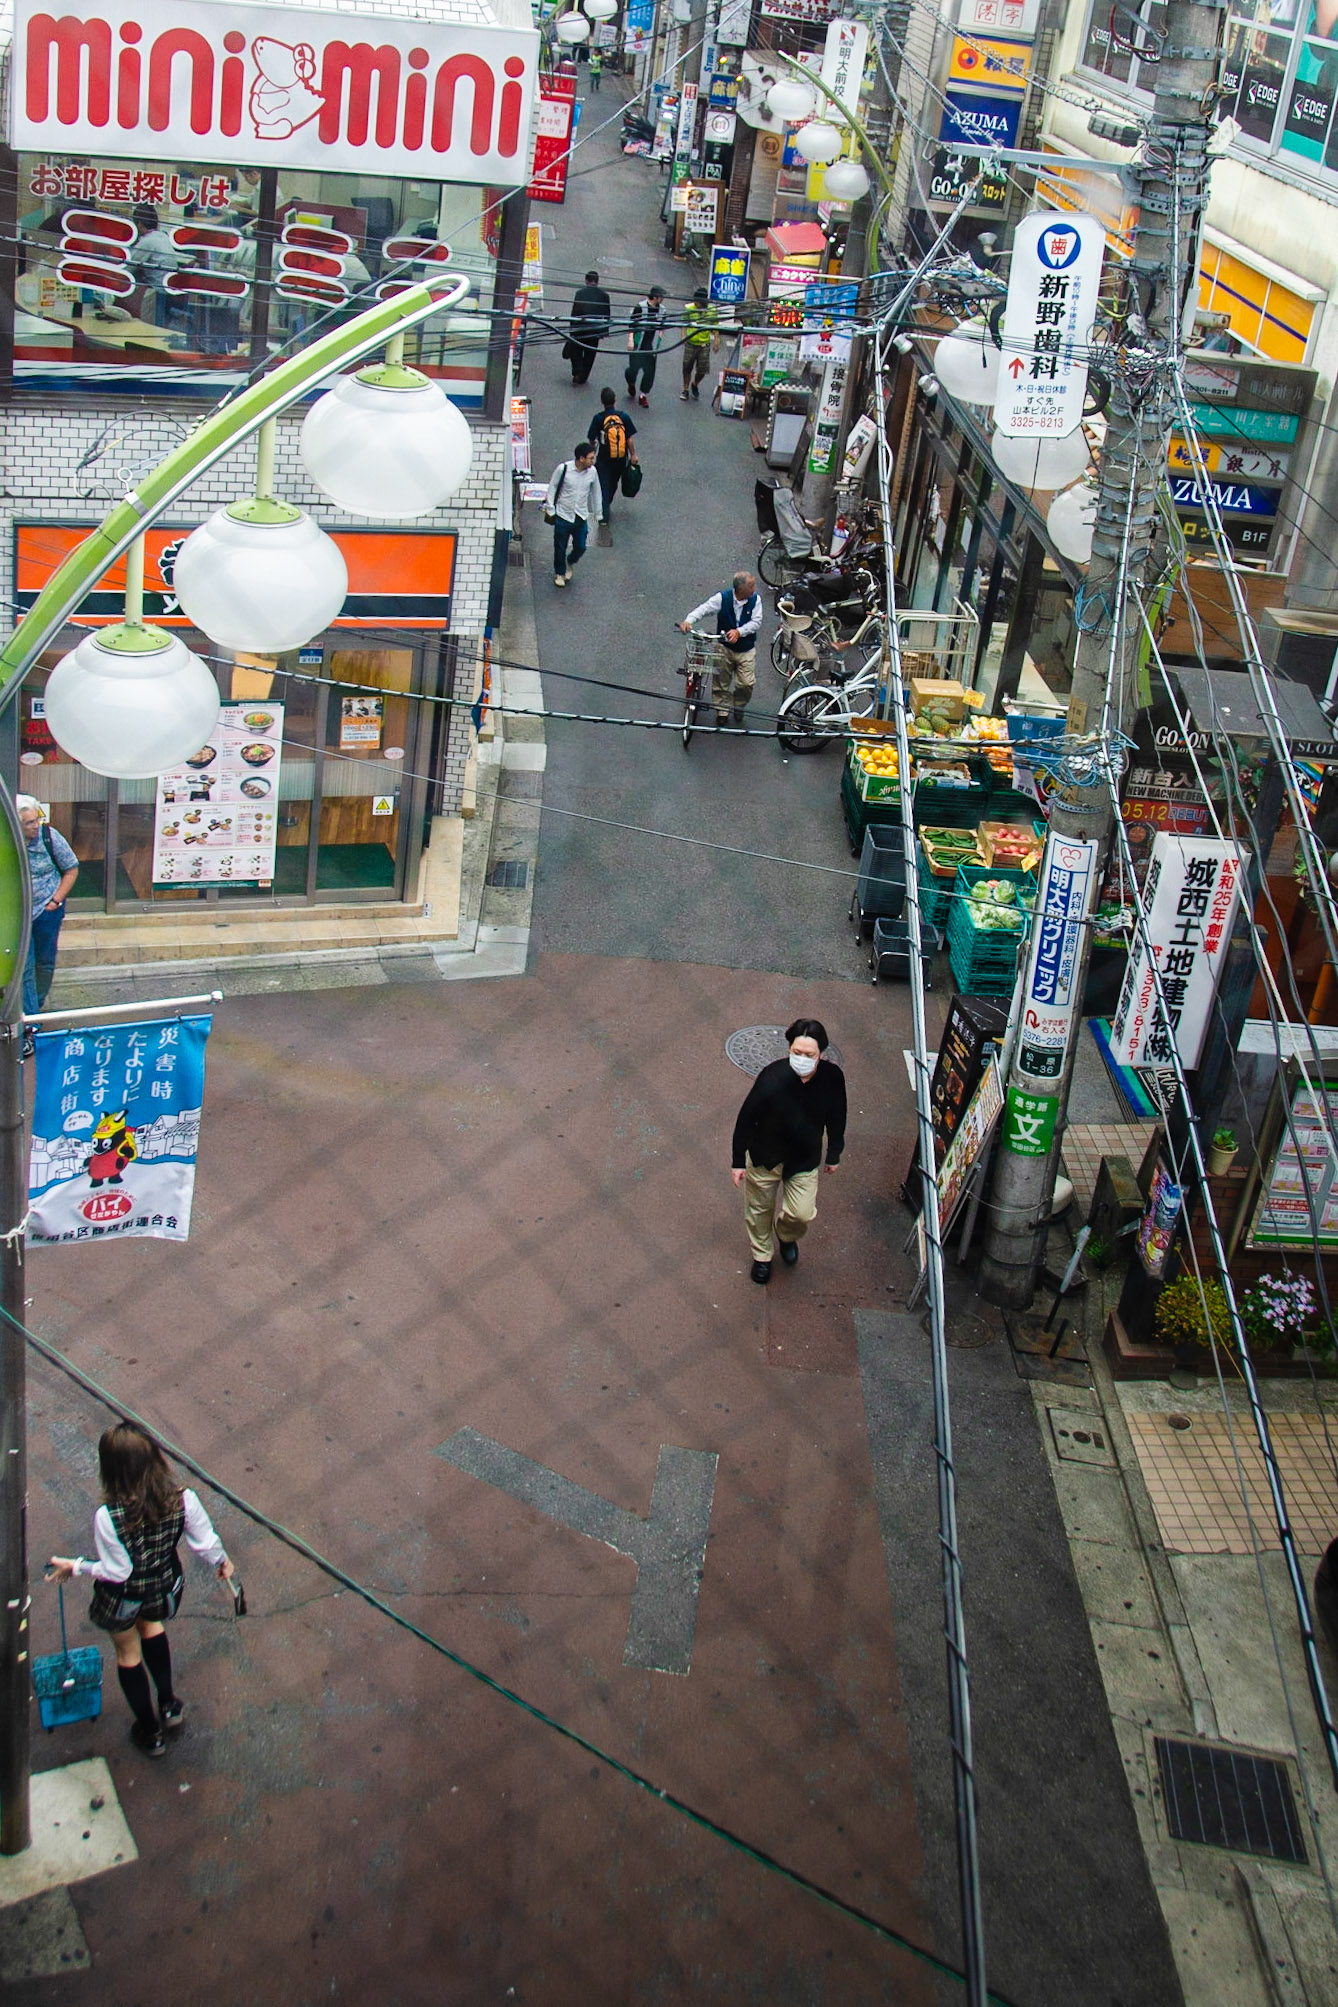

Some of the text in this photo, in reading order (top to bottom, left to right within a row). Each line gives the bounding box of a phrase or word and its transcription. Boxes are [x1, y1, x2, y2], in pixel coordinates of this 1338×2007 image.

[834, 47, 852, 98] 明大前校
[26, 13, 526, 158] mini mini
[1257, 84, 1279, 103] EDGE
[1303, 98, 1328, 119] EDGE
[950, 111, 1009, 132] AZUMA
[29, 164, 231, 209] お部屋探しは
[982, 183, 1006, 201] スロット
[1051, 238, 1067, 255] 歯
[1029, 273, 1070, 380] 新野歯科
[828, 367, 845, 407] 接骨院
[1016, 384, 1067, 394] 木・日・祝日休診
[1012, 406, 1064, 416] 山本ビル2F
[1026, 396, 1054, 406] すぐ先
[1010, 416, 1064, 429] 3325-8213
[1226, 454, 1281, 478] 銀ノ月
[1242, 530, 1268, 543] B1F
[1155, 725, 1178, 746] GO
[1297, 741, 1337, 755] SLOT
[1126, 786, 1146, 796] NEW
[1147, 787, 1184, 800] MACHINE
[1121, 801, 1168, 821] 05.12
[1203, 858, 1240, 954] 昭和25年創業
[1034, 867, 1071, 1001] 明大前クリニック
[1042, 1017, 1069, 1027] みずほ銀行
[1042, 1026, 1067, 1034] 右入る
[1022, 1028, 1067, 1046] 5376-2281
[90, 1034, 115, 1107] なります
[122, 1031, 148, 1105] たよりに
[151, 1027, 179, 1100] 災害時
[1026, 1061, 1054, 1074] 1-36
[60, 1038, 84, 1116] 商店街
[1014, 1095, 1049, 1112] 通学路
[1009, 1113, 1045, 1145] 文
[91, 1196, 123, 1213] バイ
[31, 1213, 179, 1241] 世田谷区商店街連合会
